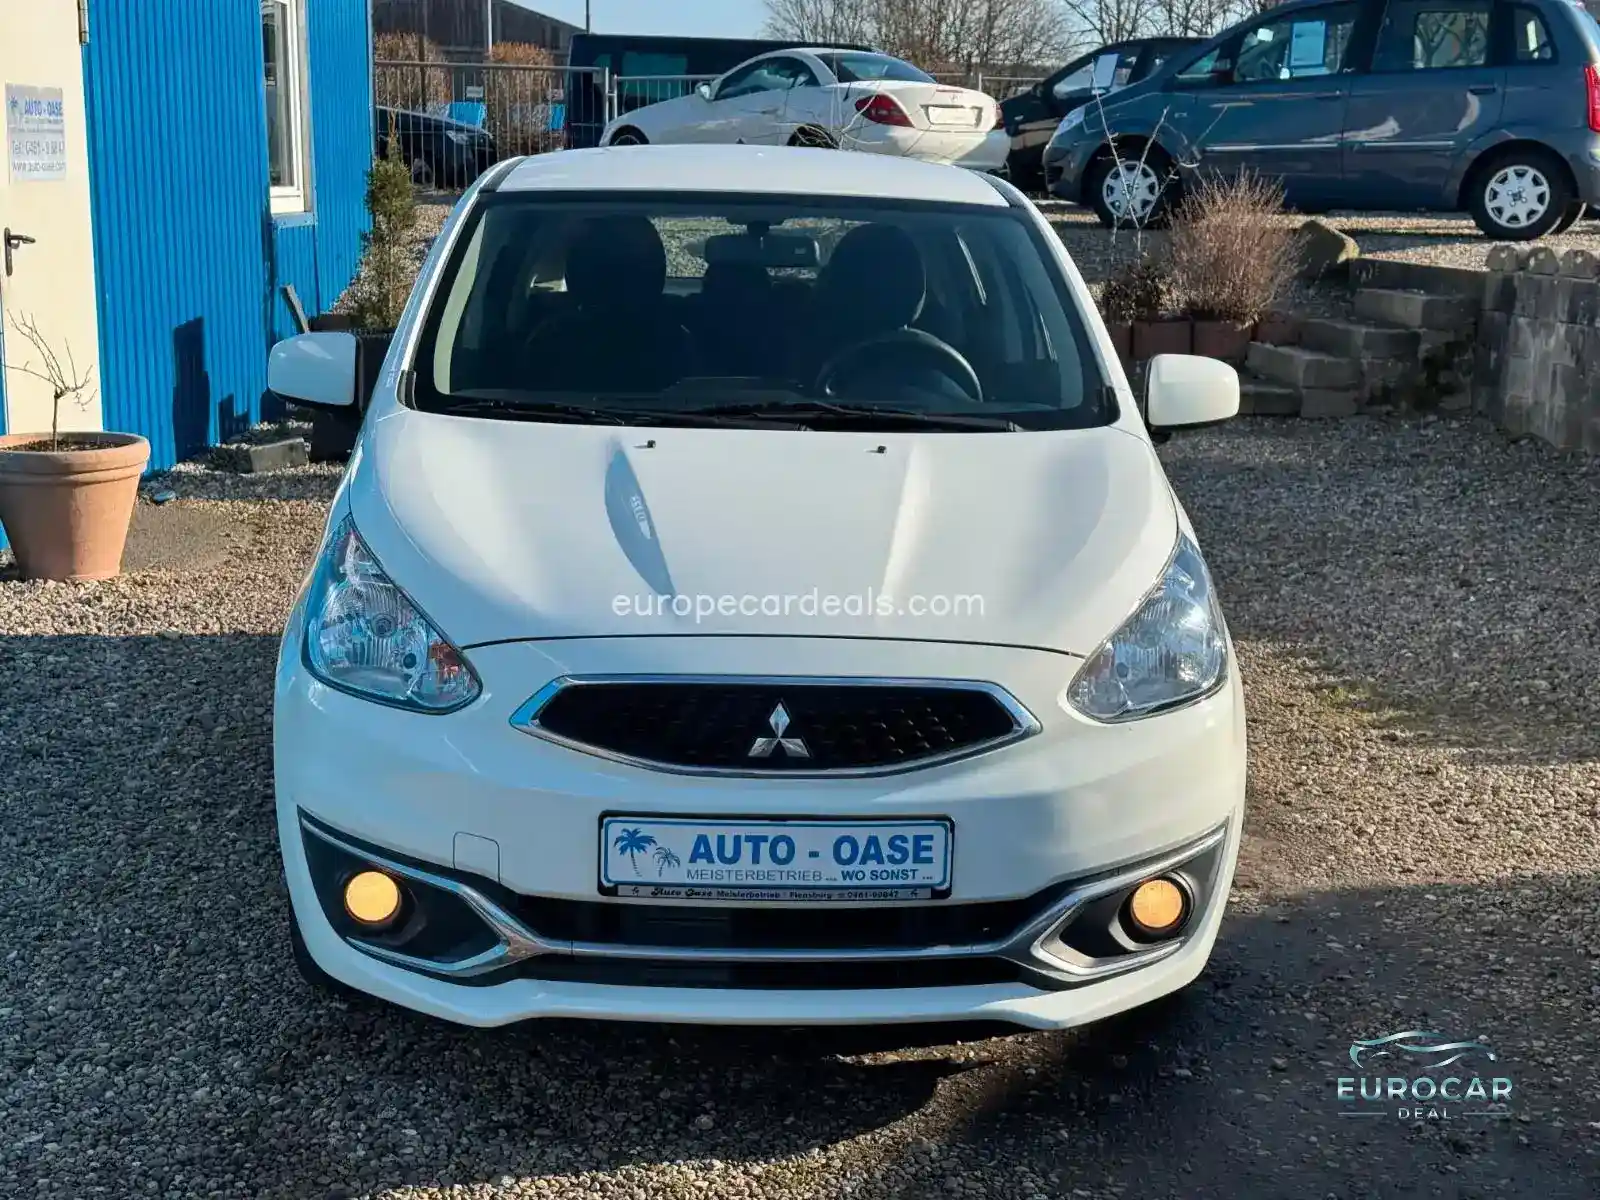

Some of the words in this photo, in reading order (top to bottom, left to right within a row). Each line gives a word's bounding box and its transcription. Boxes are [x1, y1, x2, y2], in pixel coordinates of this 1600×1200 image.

[25, 100, 42, 116] AUTO
[47, 101, 63, 117] OASE
[688, 833, 796, 866] AUTO
[832, 834, 934, 866] OASE
[841, 870, 866, 881] WO
[869, 868, 919, 881] SONST
